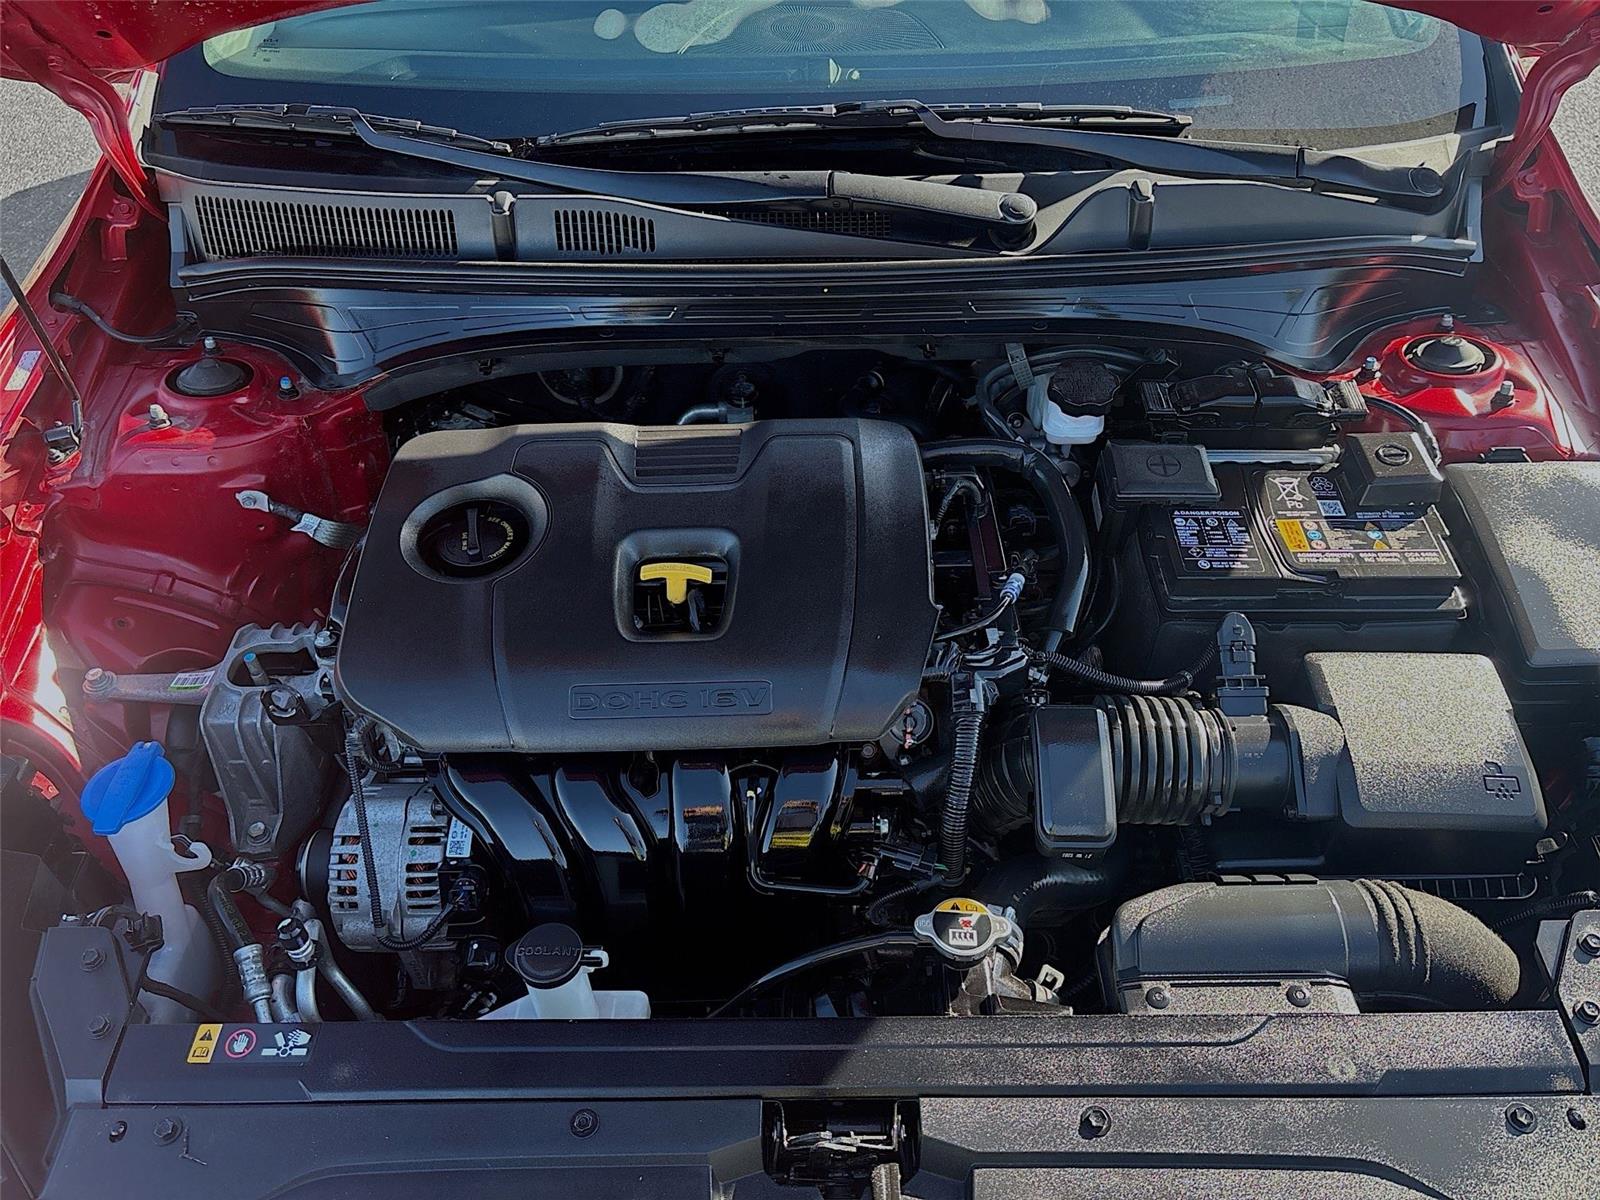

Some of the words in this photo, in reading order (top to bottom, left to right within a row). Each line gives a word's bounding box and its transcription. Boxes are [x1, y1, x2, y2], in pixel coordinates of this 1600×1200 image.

[1286, 501, 1304, 509] Pb
[487, 541, 512, 559] MANUAL
[573, 689, 689, 712] DOHC
[699, 687, 768, 709] 16V
[517, 945, 580, 957] COOLANT
